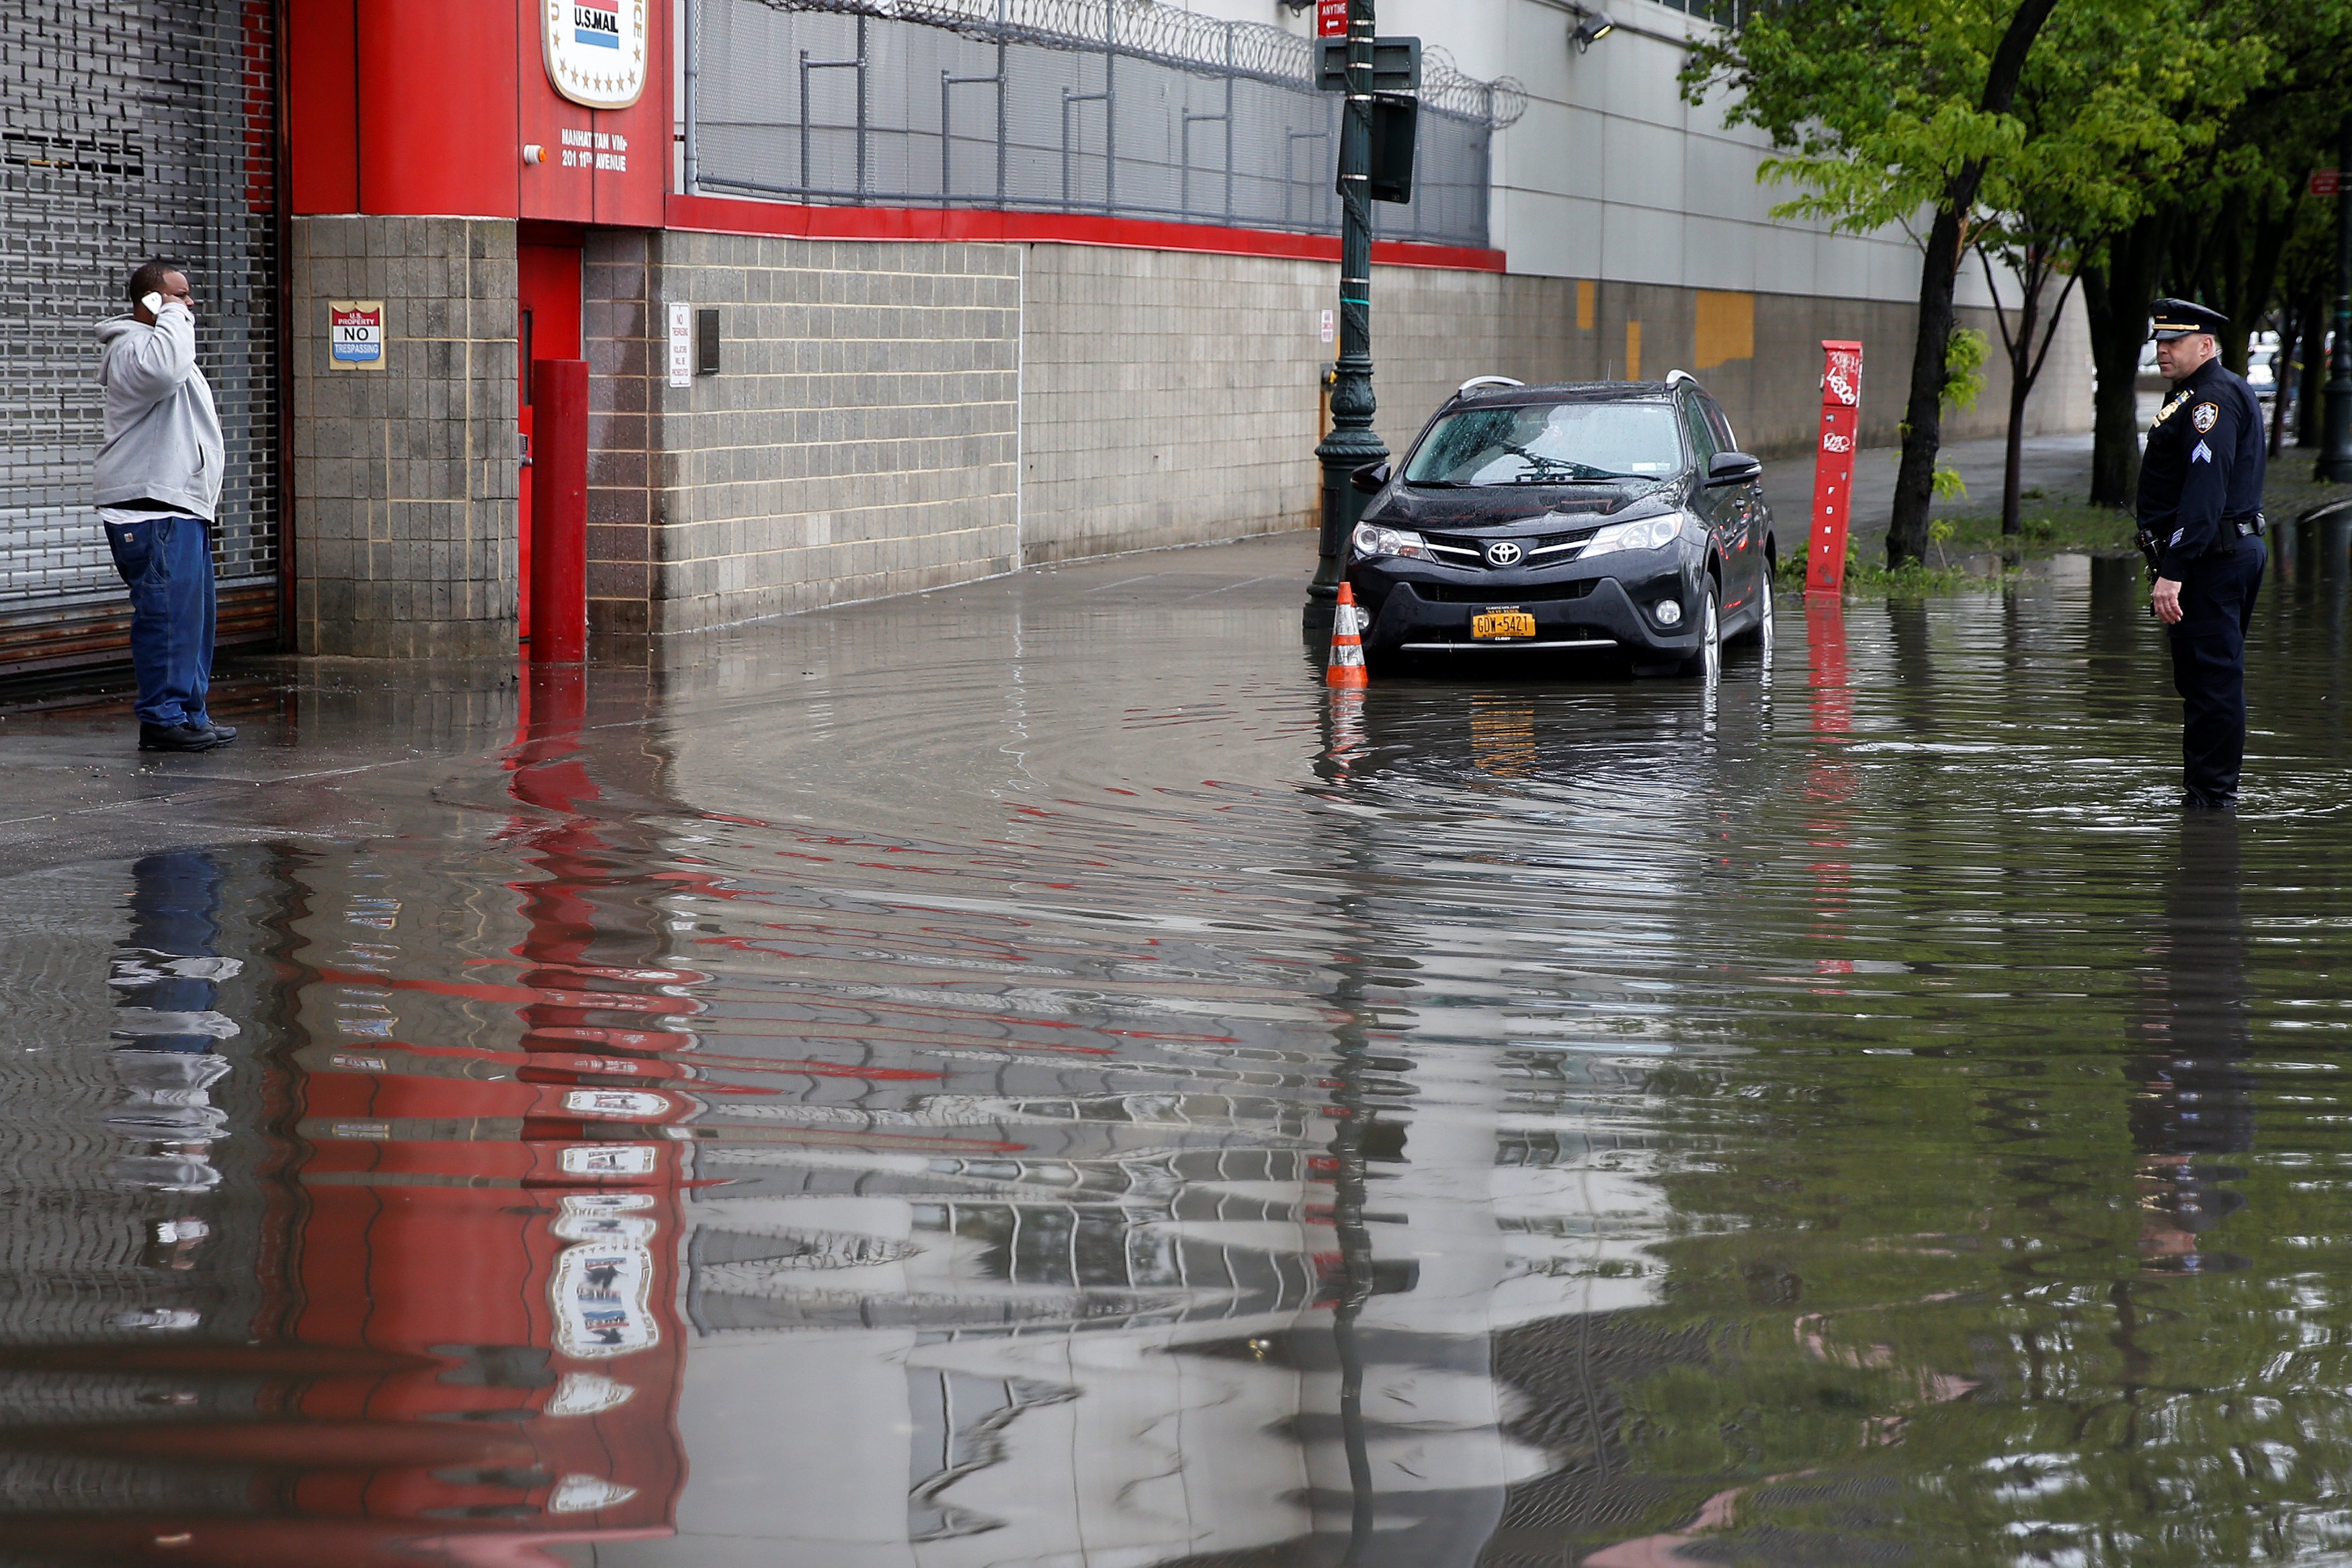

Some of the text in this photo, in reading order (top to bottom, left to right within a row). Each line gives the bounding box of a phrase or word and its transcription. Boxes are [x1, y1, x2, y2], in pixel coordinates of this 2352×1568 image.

[1321, 3, 1346, 15] ANYTIME
[562, 128, 609, 149] MANHATTAN
[562, 149, 576, 167] 201
[595, 153, 626, 172] AVENUE
[344, 327, 368, 341] NO
[335, 344, 378, 354] TRESPASSING
